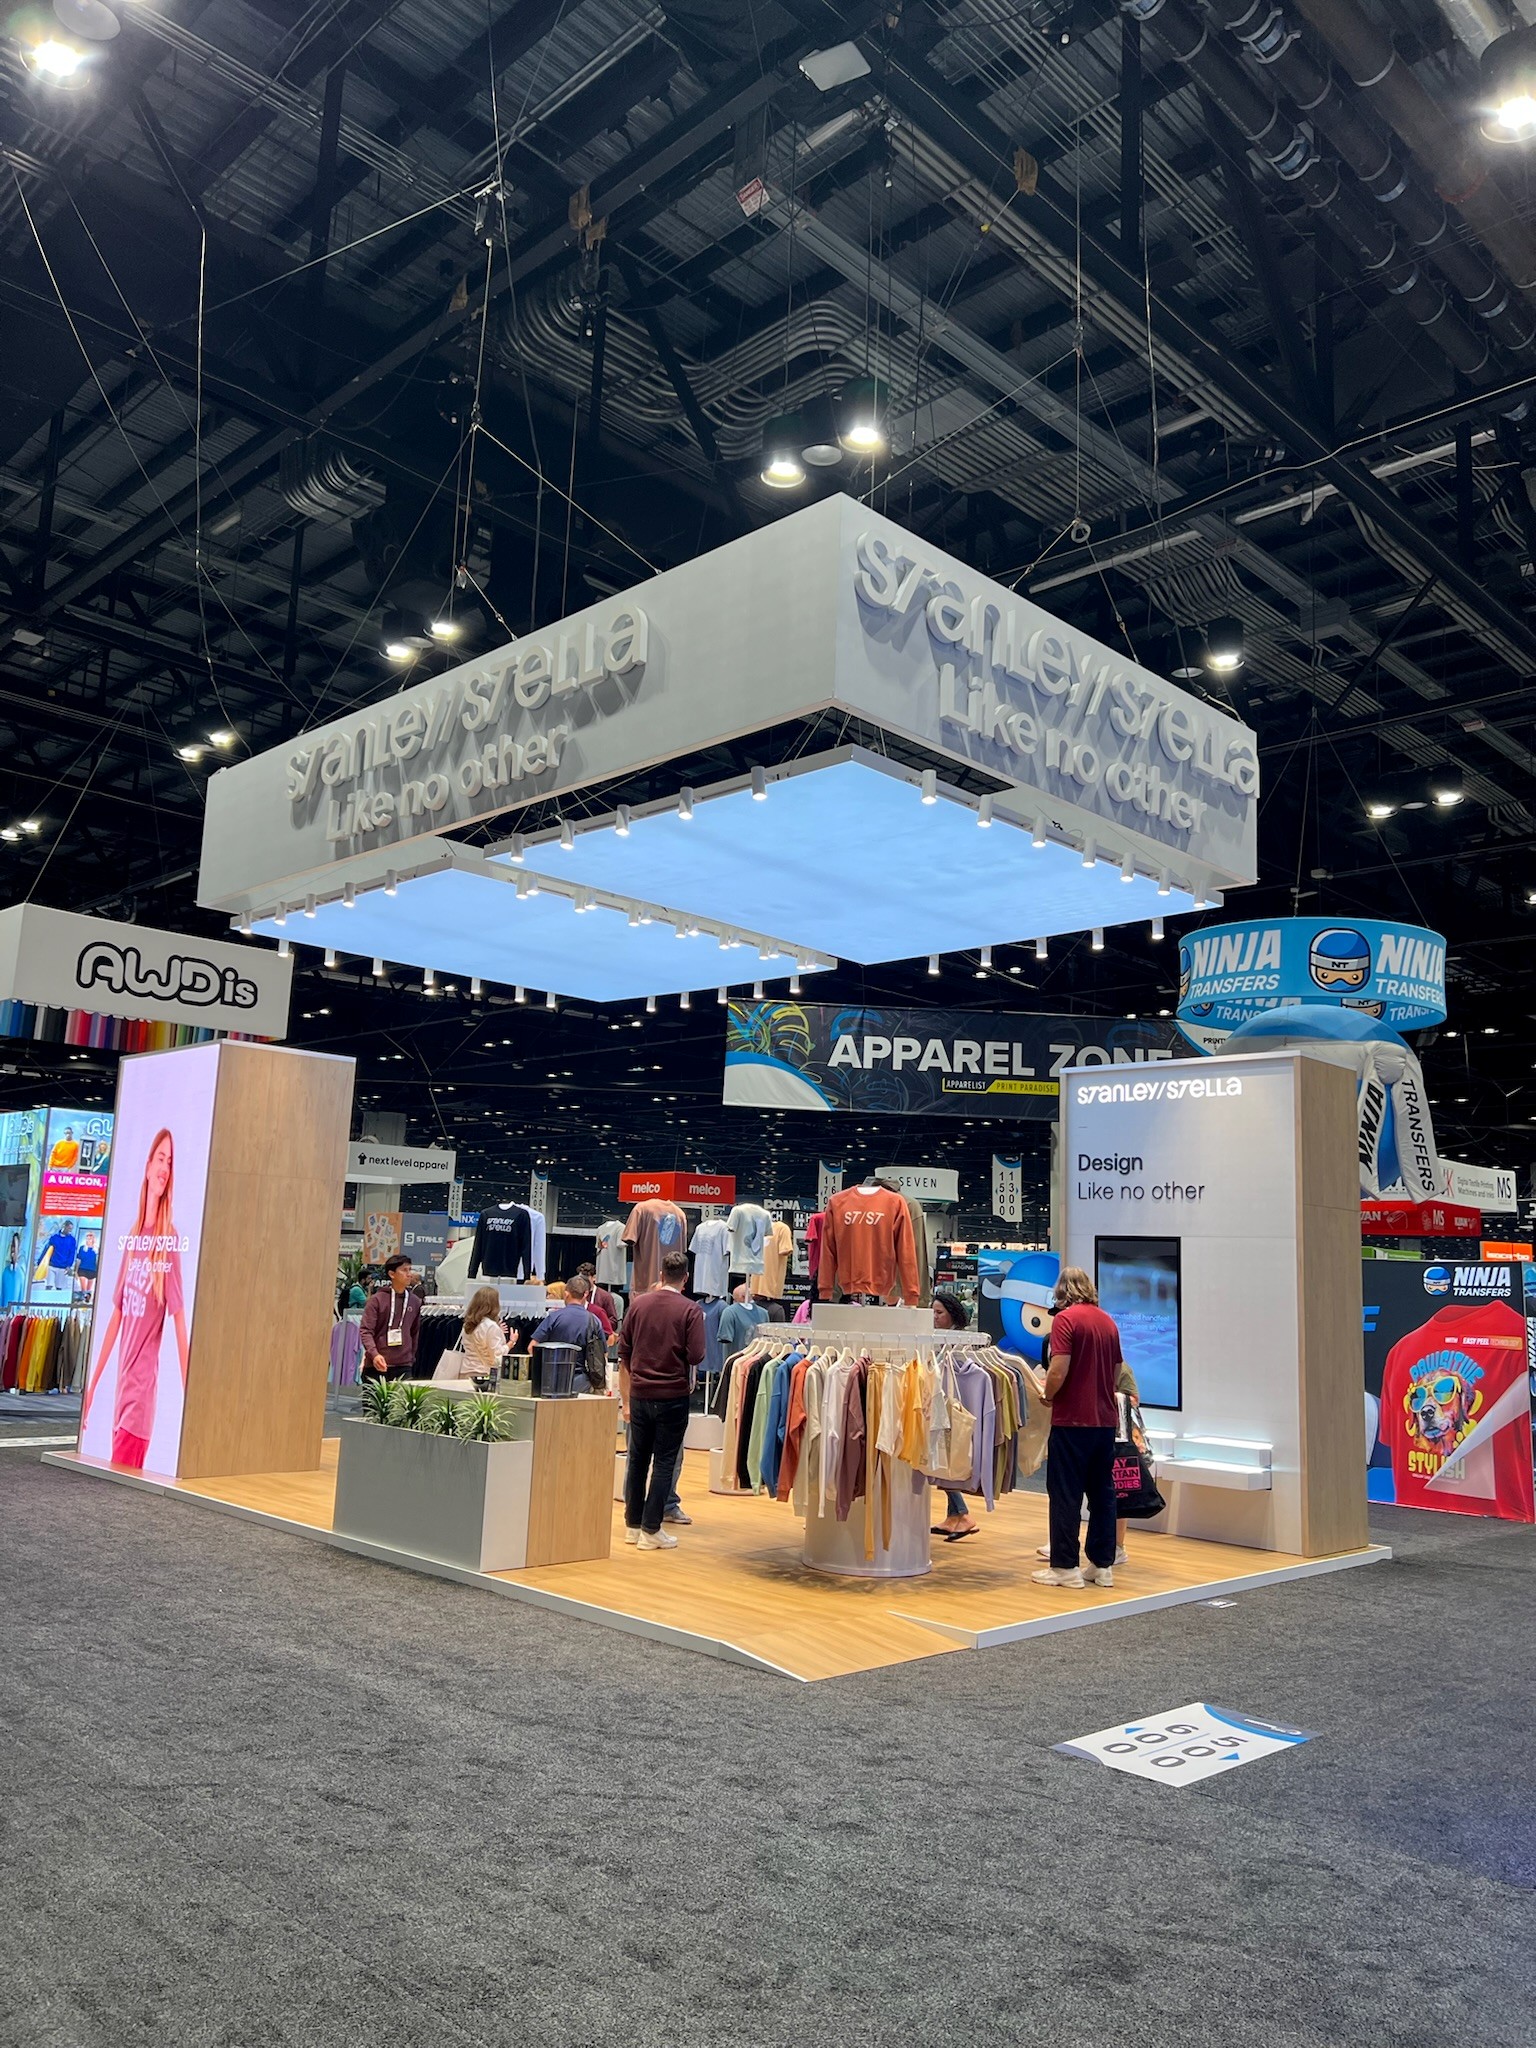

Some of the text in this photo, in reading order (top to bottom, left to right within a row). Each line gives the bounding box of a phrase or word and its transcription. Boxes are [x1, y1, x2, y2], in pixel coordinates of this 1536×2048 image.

[940, 662, 1206, 834] Like no other
[325, 724, 569, 842] Like no other
[1192, 930, 1281, 980] NINJA
[1375, 934, 1443, 987] NINJA
[1331, 961, 1350, 969] NT
[1190, 974, 1281, 999] TRANSFERS
[827, 1034, 1036, 1077] APPAREL
[946, 1080, 986, 1090] APPARELIST
[996, 1082, 1054, 1093] PRINT PARADISE
[1401, 1079, 1435, 1192] TRANSFERS
[369, 1157, 449, 1170] next level apparel
[1078, 1153, 1143, 1175] Design
[48, 1175, 57, 1184] A
[58, 1175, 73, 1185] UK
[632, 1181, 661, 1194] melco
[688, 1182, 722, 1196] melco
[899, 1176, 937, 1188] SEVEN
[1497, 1176, 1512, 1199] MS
[998, 1171, 1006, 1216] 1500
[1078, 1181, 1206, 1201] Like no other
[844, 1210, 884, 1226] ST/ST
[1433, 1209, 1445, 1226] MS
[153, 1260, 173, 1273] other
[1453, 1266, 1511, 1287] NINJA
[1453, 1287, 1511, 1297] TRANSFERS
[1462, 1337, 1476, 1345] EASY
[1476, 1338, 1490, 1346] PEEL
[1409, 1350, 1485, 1387] PAWSITIVE
